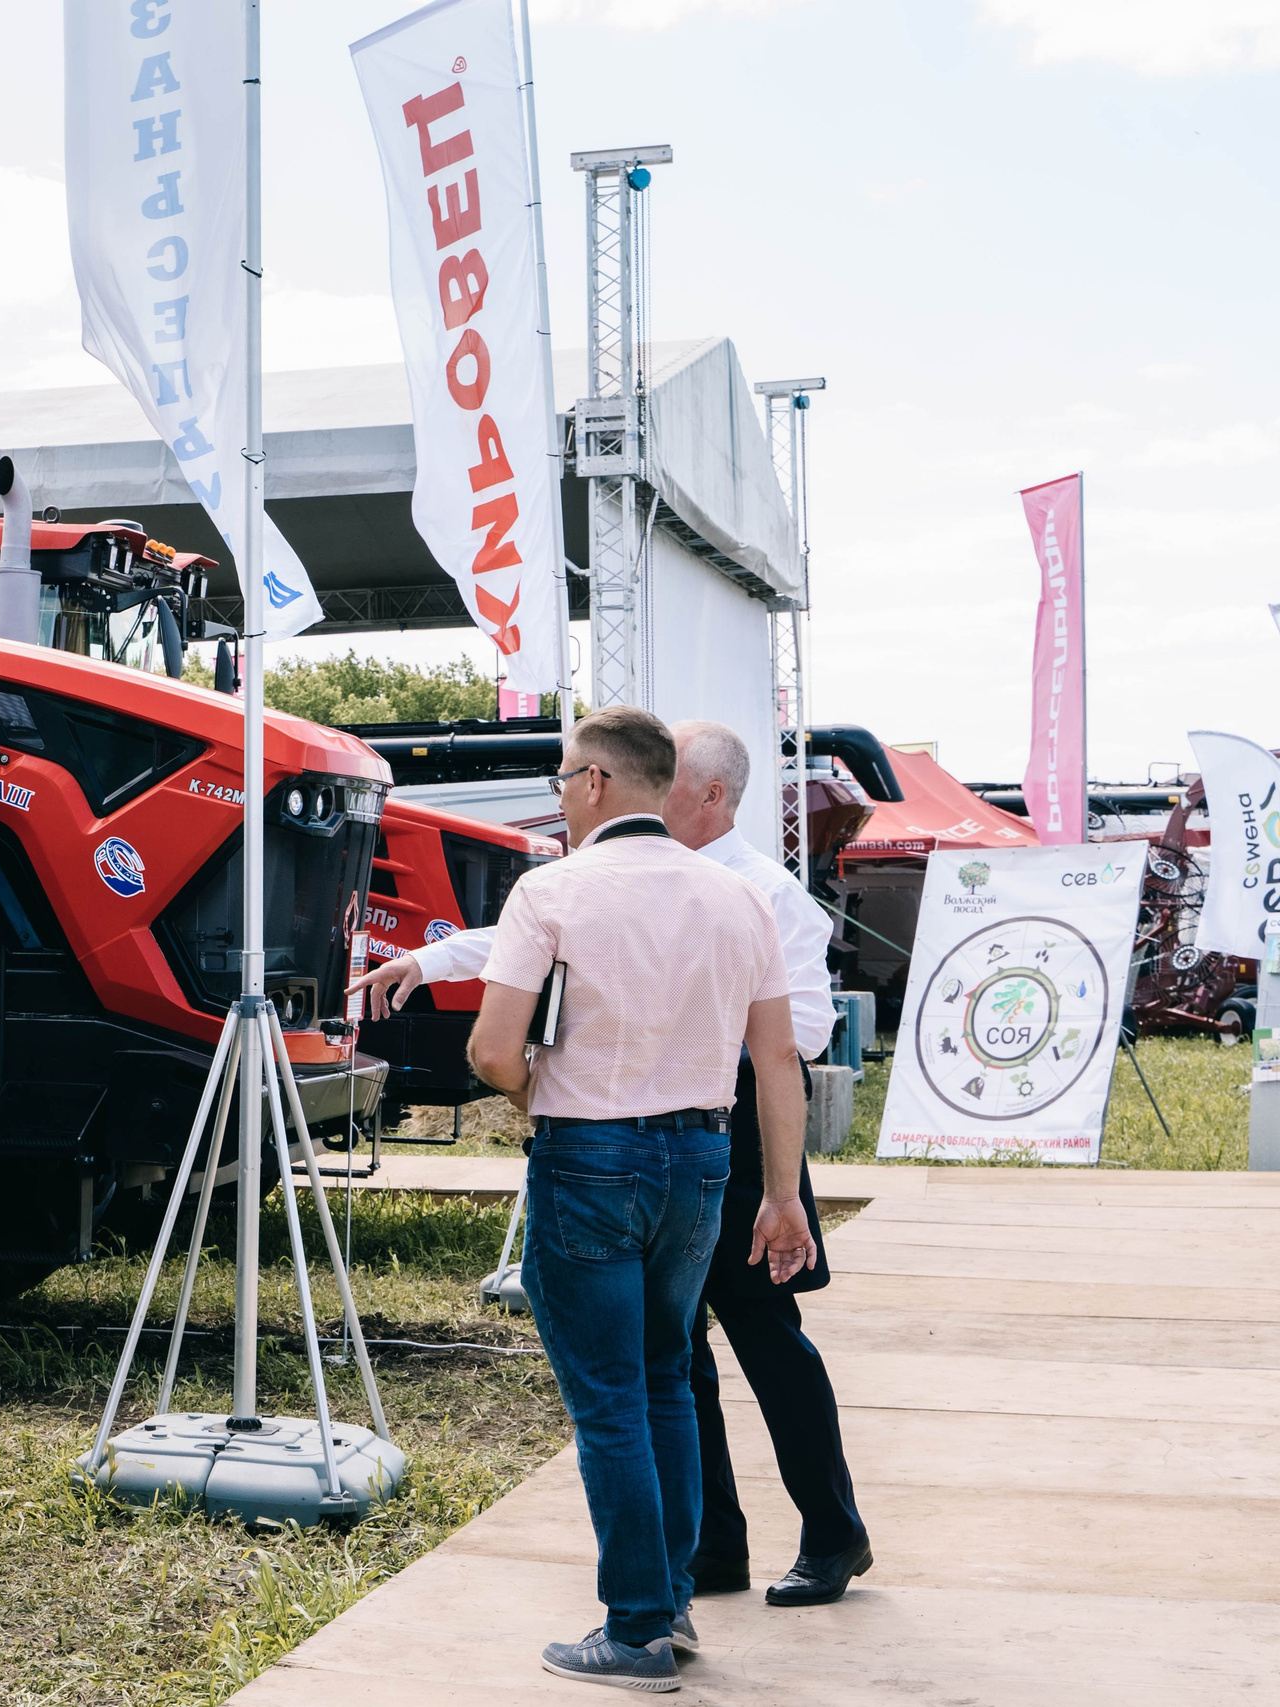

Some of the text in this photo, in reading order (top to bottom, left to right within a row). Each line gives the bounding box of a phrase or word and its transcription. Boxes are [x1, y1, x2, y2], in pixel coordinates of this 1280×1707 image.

[944, 894, 997, 907] Волжский
[986, 1027, 1032, 1045] СОЯ
[891, 1132, 945, 1145] САМАРСКАЯ
[1062, 1136, 1091, 1149] РАЙОН
